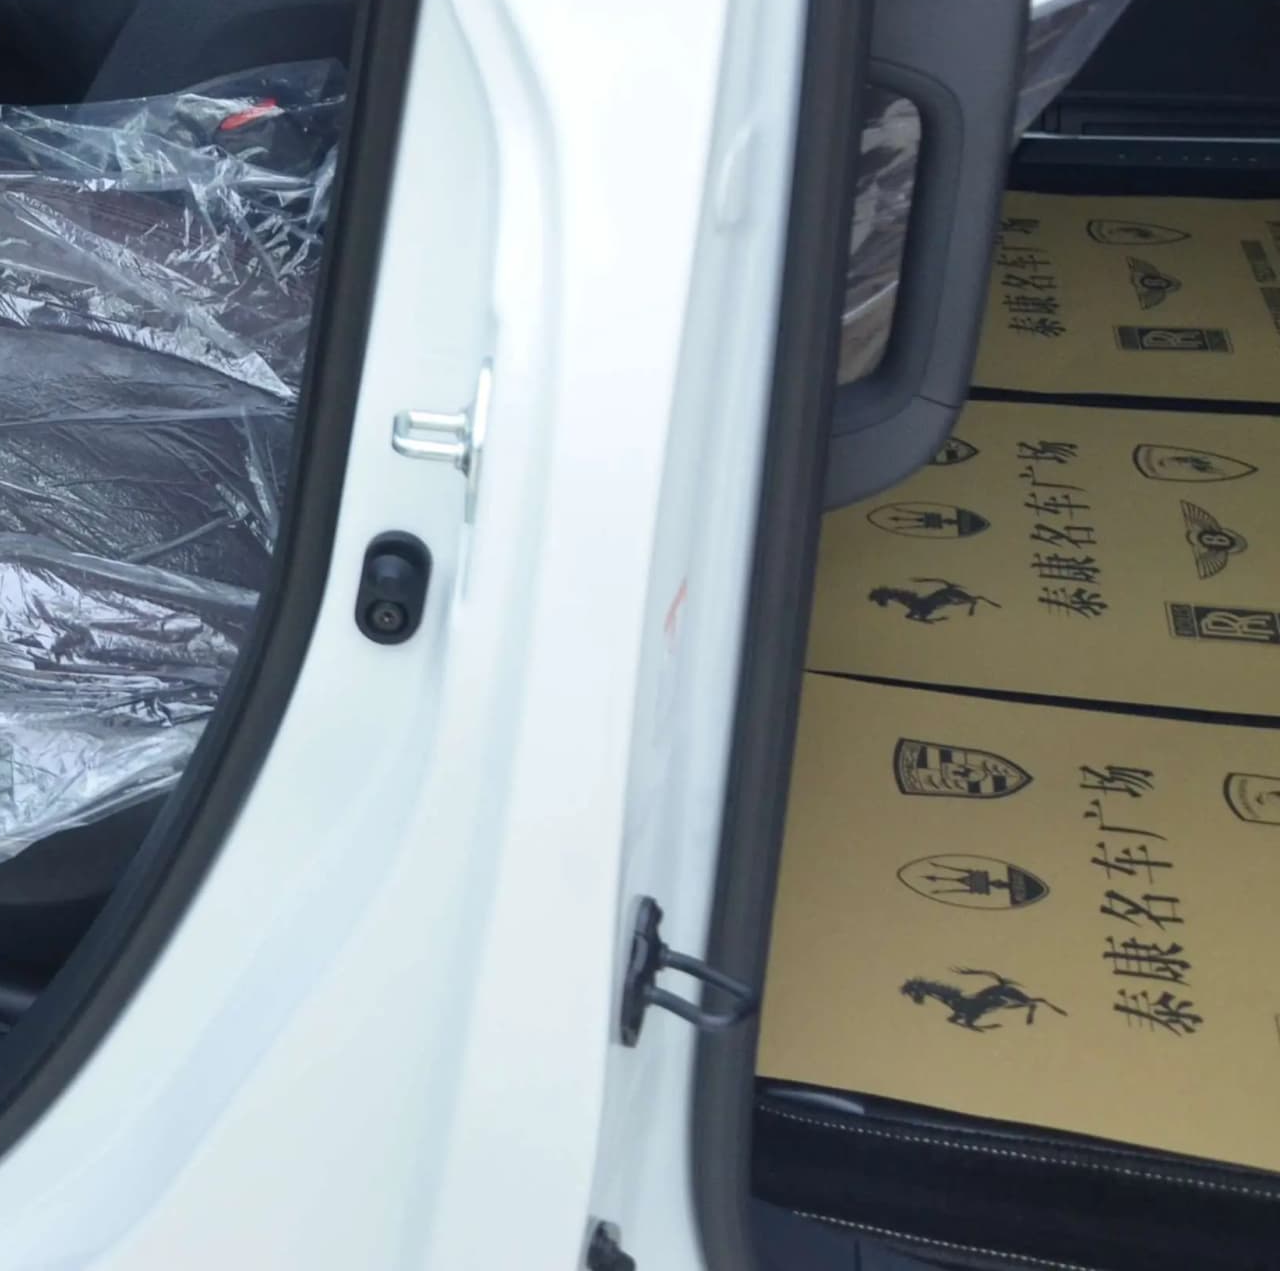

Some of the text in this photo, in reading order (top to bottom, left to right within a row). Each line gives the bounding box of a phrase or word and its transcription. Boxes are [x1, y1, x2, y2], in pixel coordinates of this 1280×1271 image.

[1017, 439, 1109, 619] 泰康名车广场
[1079, 764, 1204, 1036] 泰康名车广场
